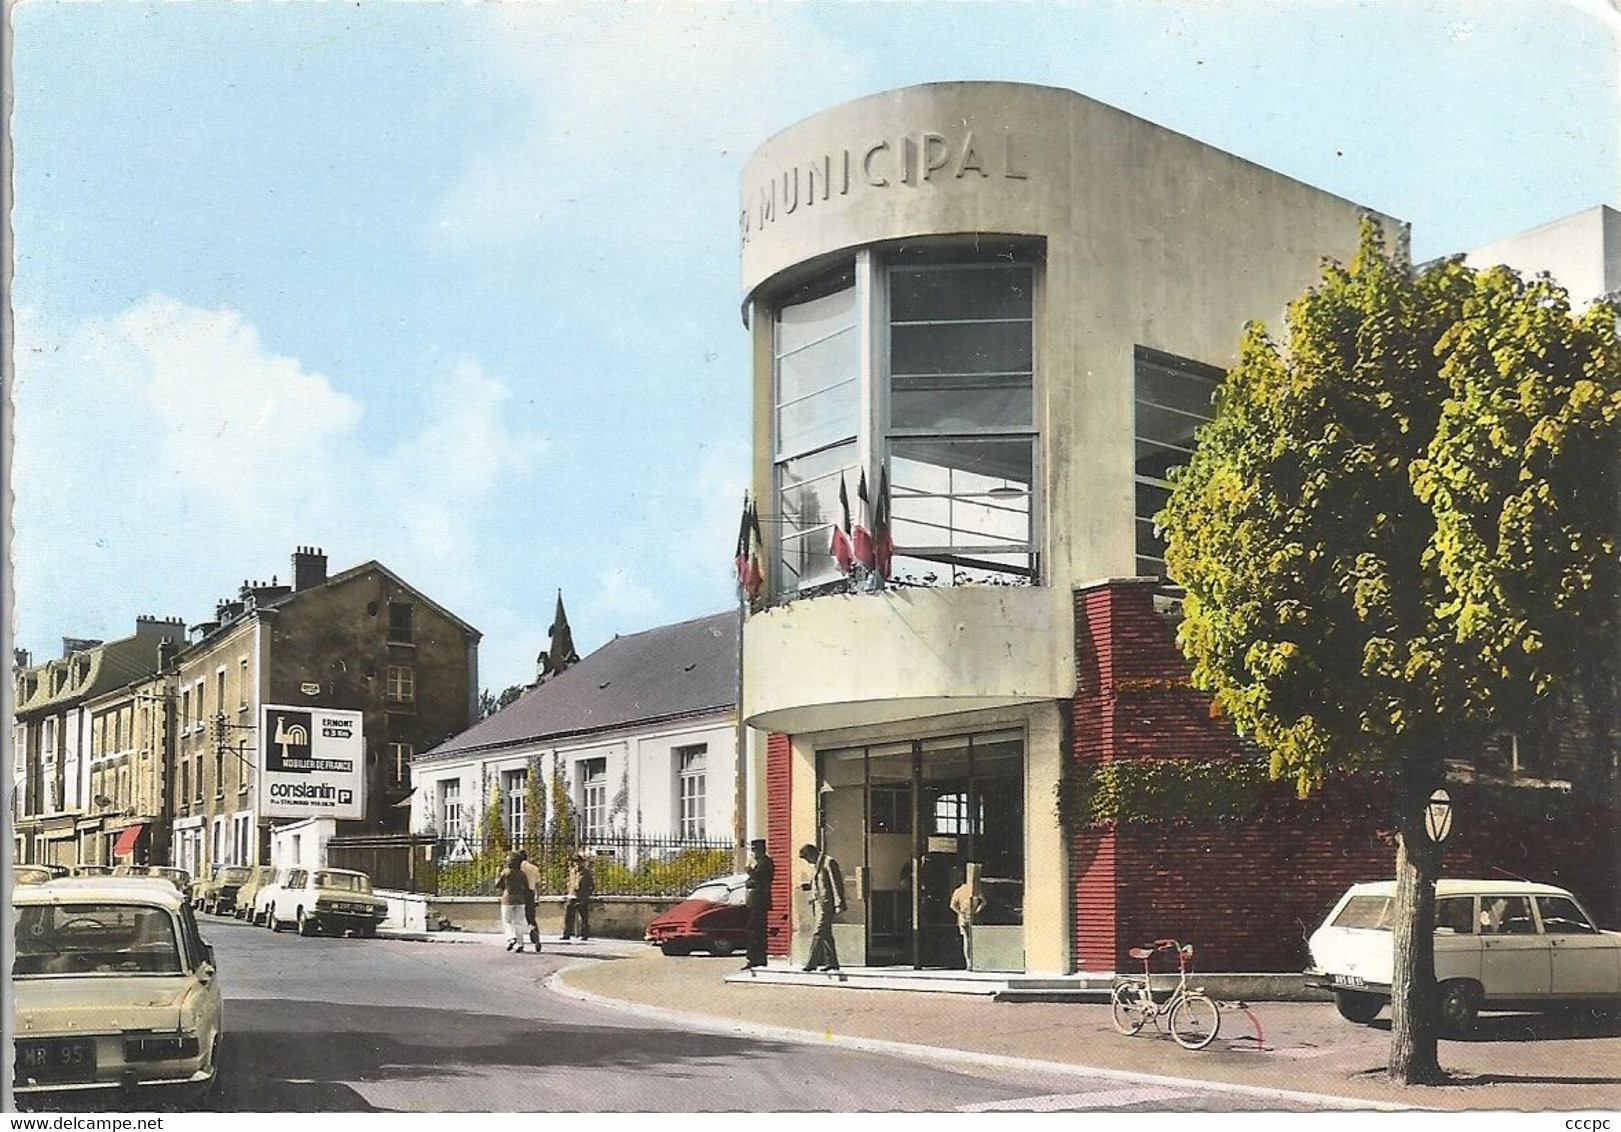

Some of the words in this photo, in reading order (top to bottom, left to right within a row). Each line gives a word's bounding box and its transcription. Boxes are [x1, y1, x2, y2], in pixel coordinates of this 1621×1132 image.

[758, 130, 1027, 230] MUNICIPAL
[322, 718, 353, 729] ERMONT
[282, 758, 316, 770] MOBILIER
[316, 760, 326, 770] DE
[326, 760, 352, 772] FRANCE
[270, 781, 335, 799] constantin
[339, 791, 351, 803] P
